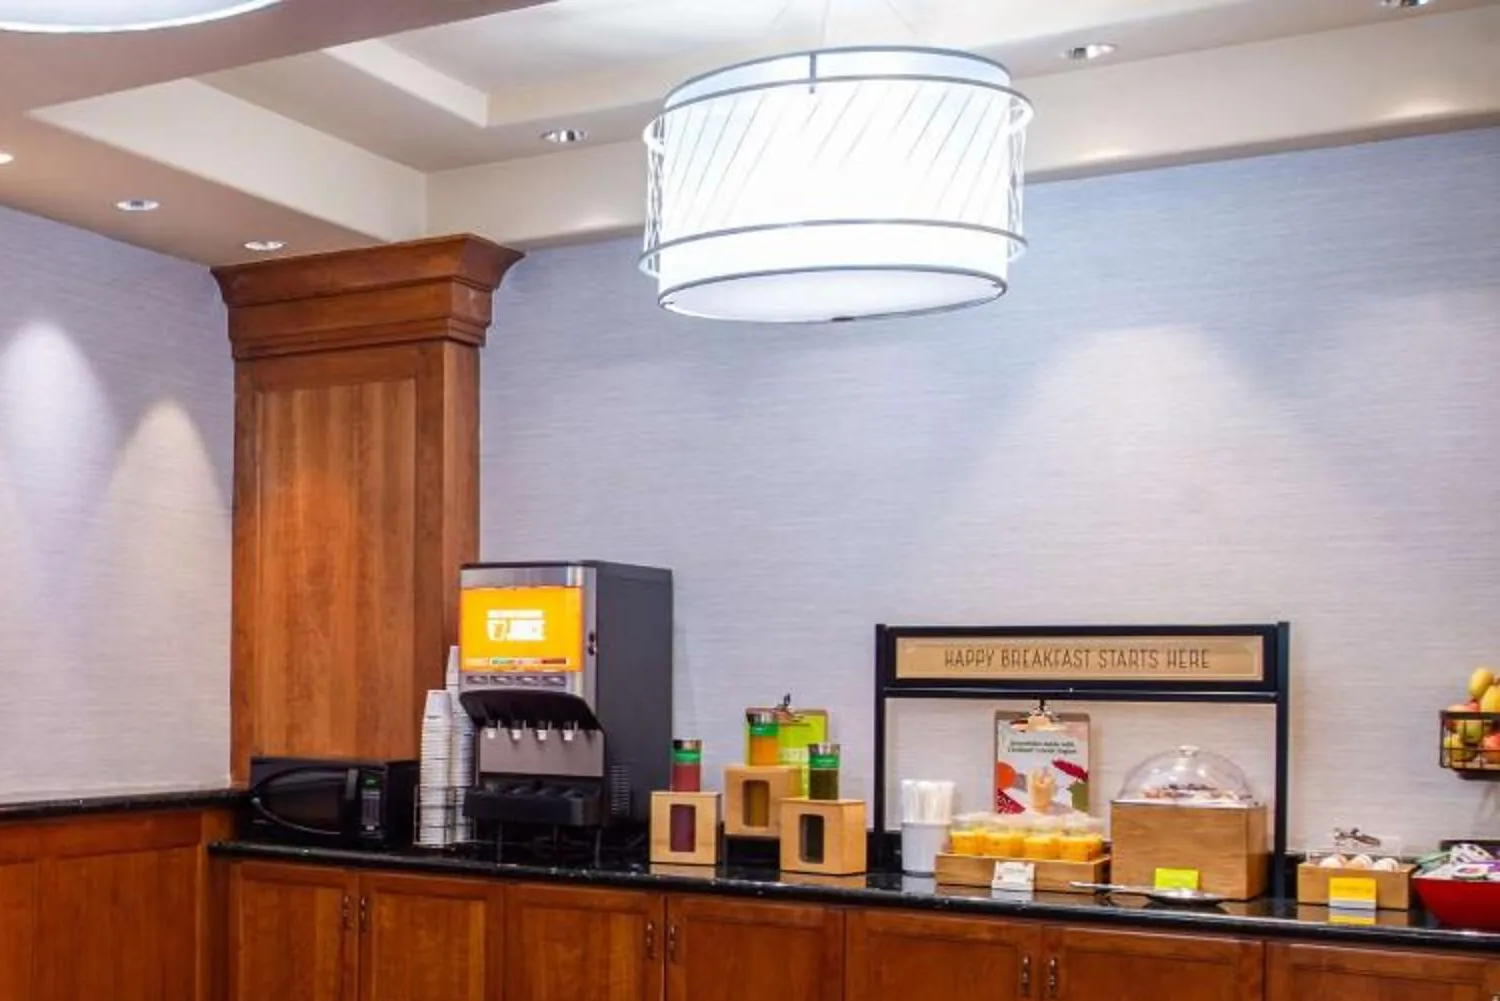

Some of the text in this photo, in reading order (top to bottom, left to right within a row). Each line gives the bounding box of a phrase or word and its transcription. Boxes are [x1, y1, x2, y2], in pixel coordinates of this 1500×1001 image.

[944, 648, 1210, 669] HAPPY BREAKFAST STARTS HERE
